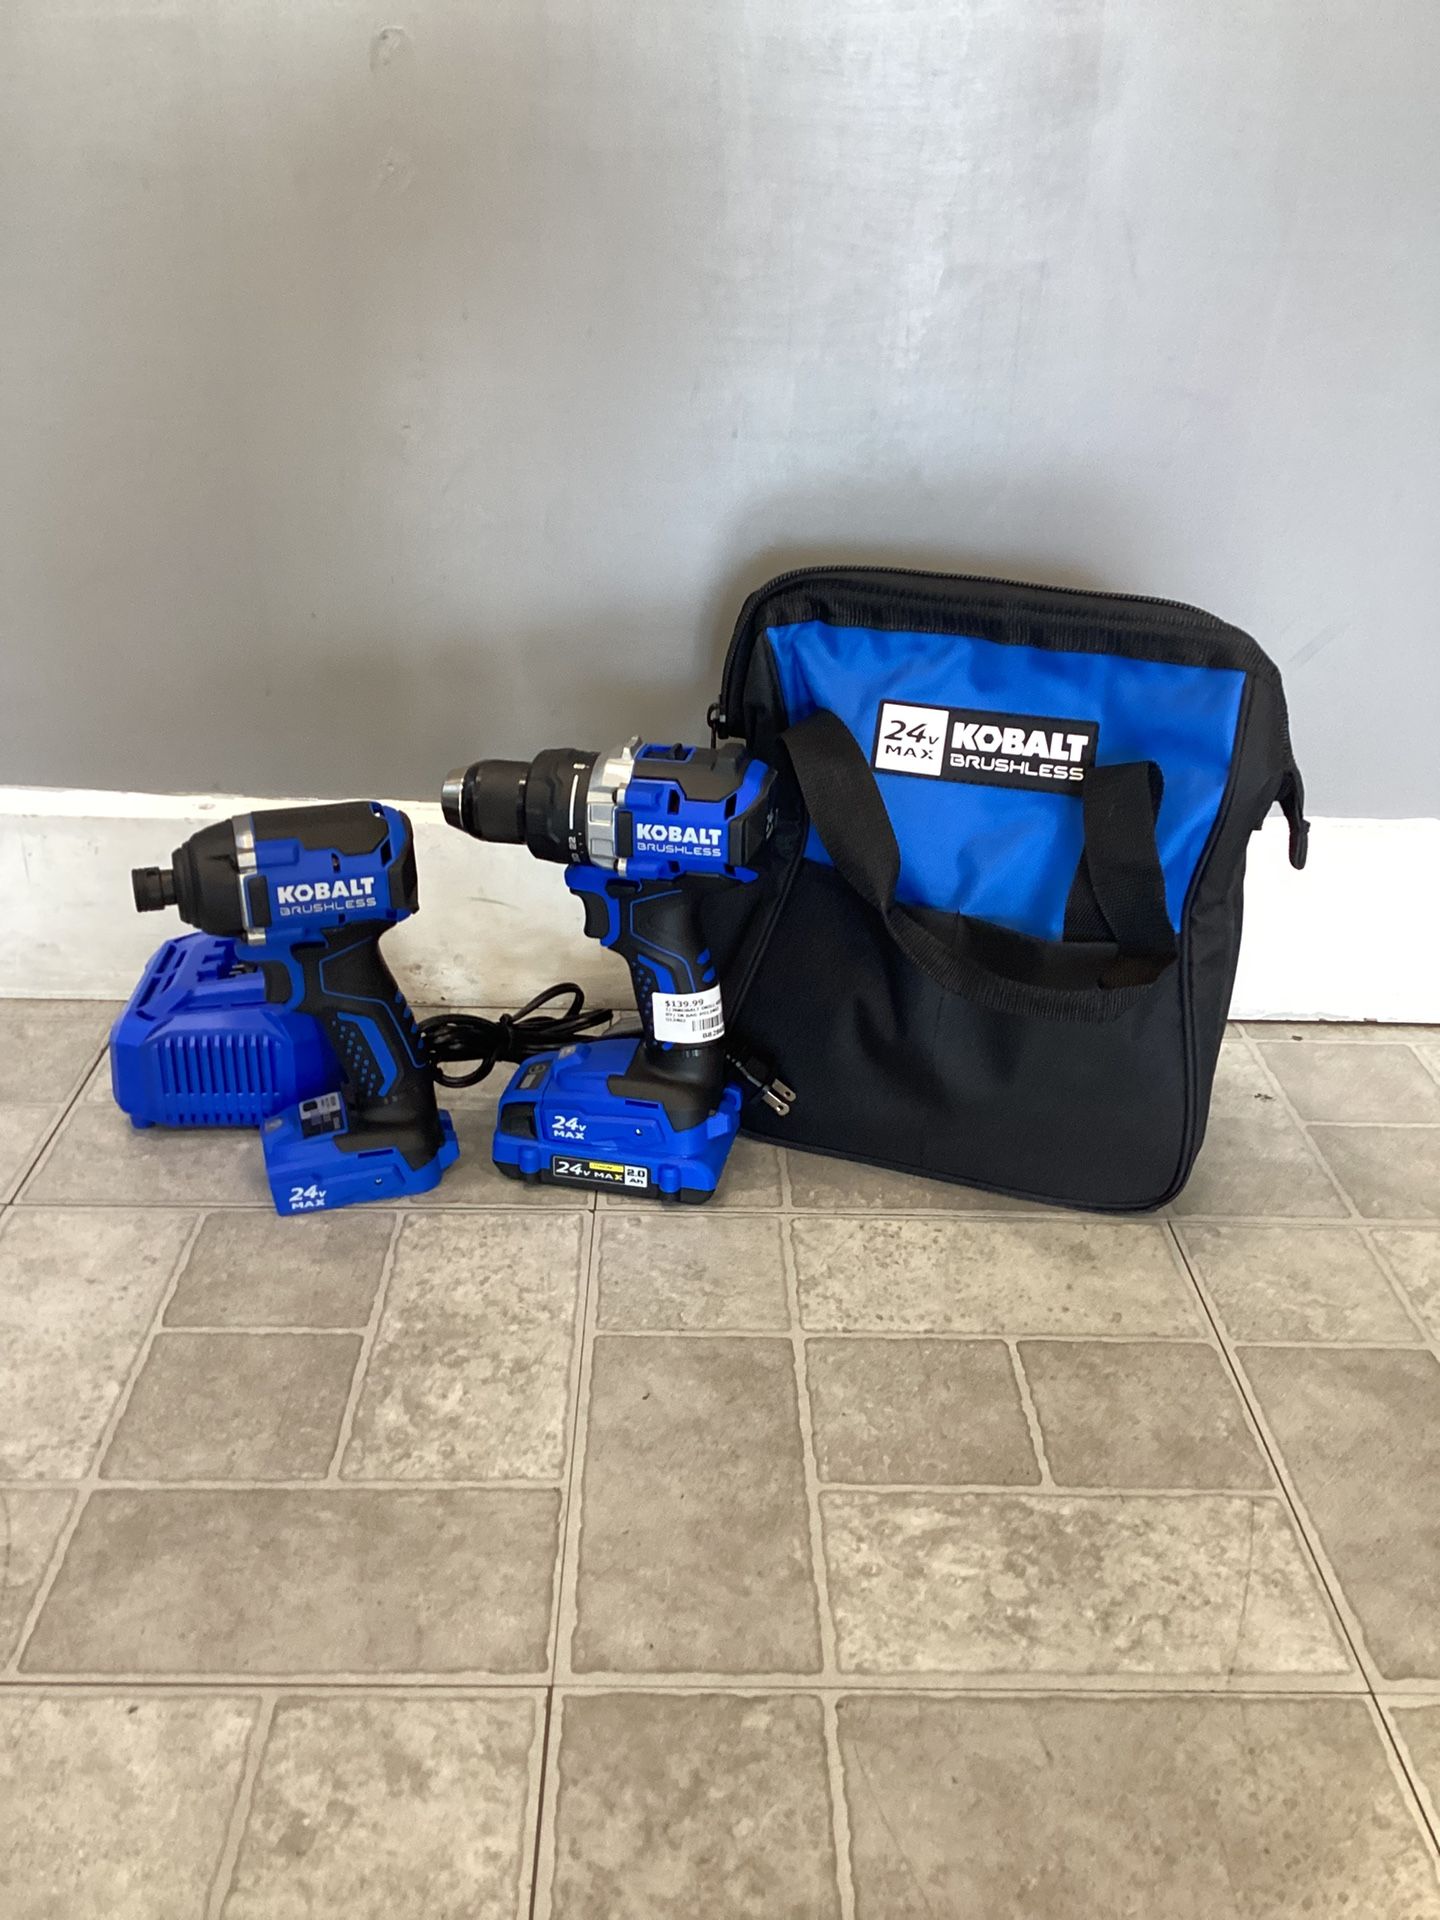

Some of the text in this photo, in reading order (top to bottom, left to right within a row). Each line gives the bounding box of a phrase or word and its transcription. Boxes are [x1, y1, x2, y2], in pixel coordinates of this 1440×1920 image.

[951, 721, 1089, 762] KOBALT
[885, 744, 934, 760] MAX
[950, 753, 1084, 781] BRUSHLESS
[636, 823, 721, 845] KOBALT
[637, 842, 722, 857] BRUSHLESS
[277, 877, 374, 904] KOBALT
[280, 898, 376, 916] BRUSHLESS
[665, 999, 704, 1007] $139.99
[553, 1130, 584, 1139] MAX
[594, 1171, 623, 1182] MAX
[627, 1168, 646, 1178] 2.0
[291, 1199, 325, 1210] MAX
